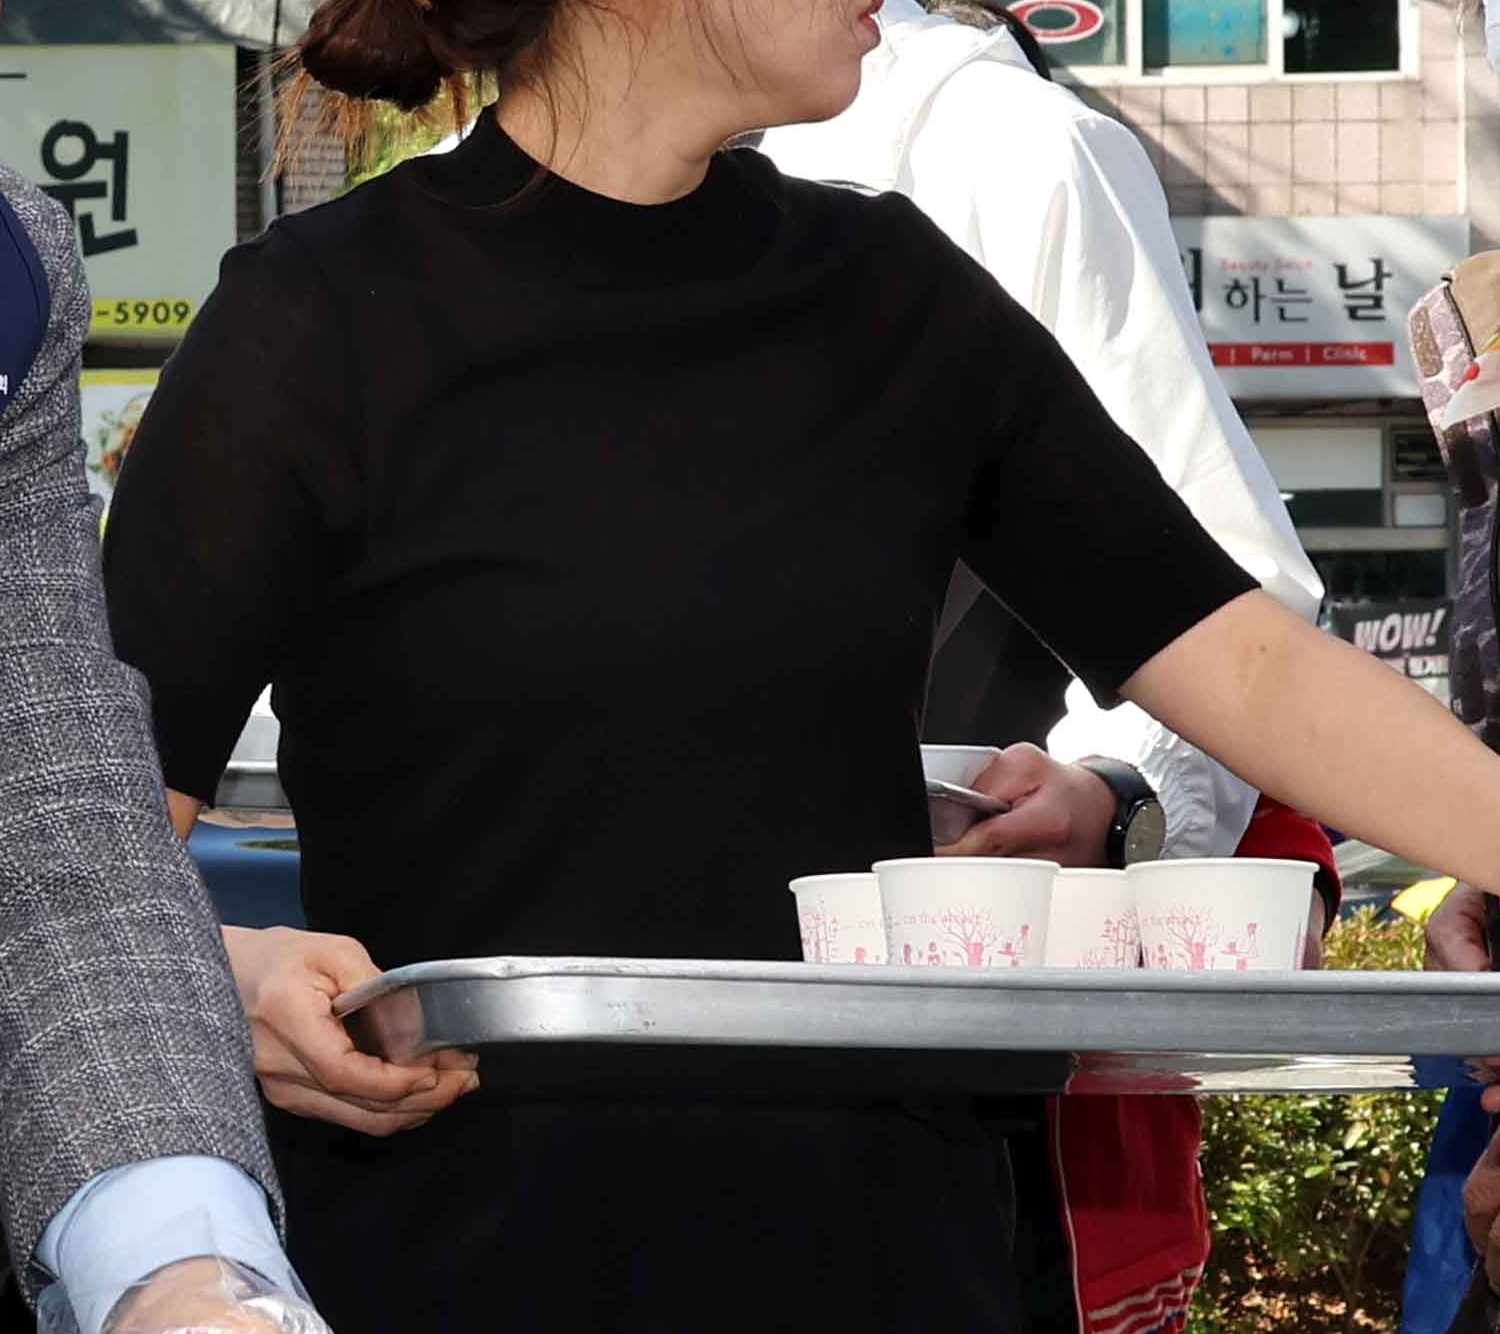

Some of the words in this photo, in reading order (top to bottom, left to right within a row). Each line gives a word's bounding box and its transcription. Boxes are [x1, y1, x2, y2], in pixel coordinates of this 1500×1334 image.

[1224, 275, 1313, 324] 하는
[1334, 257, 1393, 323] 날
[1251, 346, 1295, 362] Perm
[1322, 346, 1368, 362] Clinic
[1353, 608, 1447, 653] WOW!
